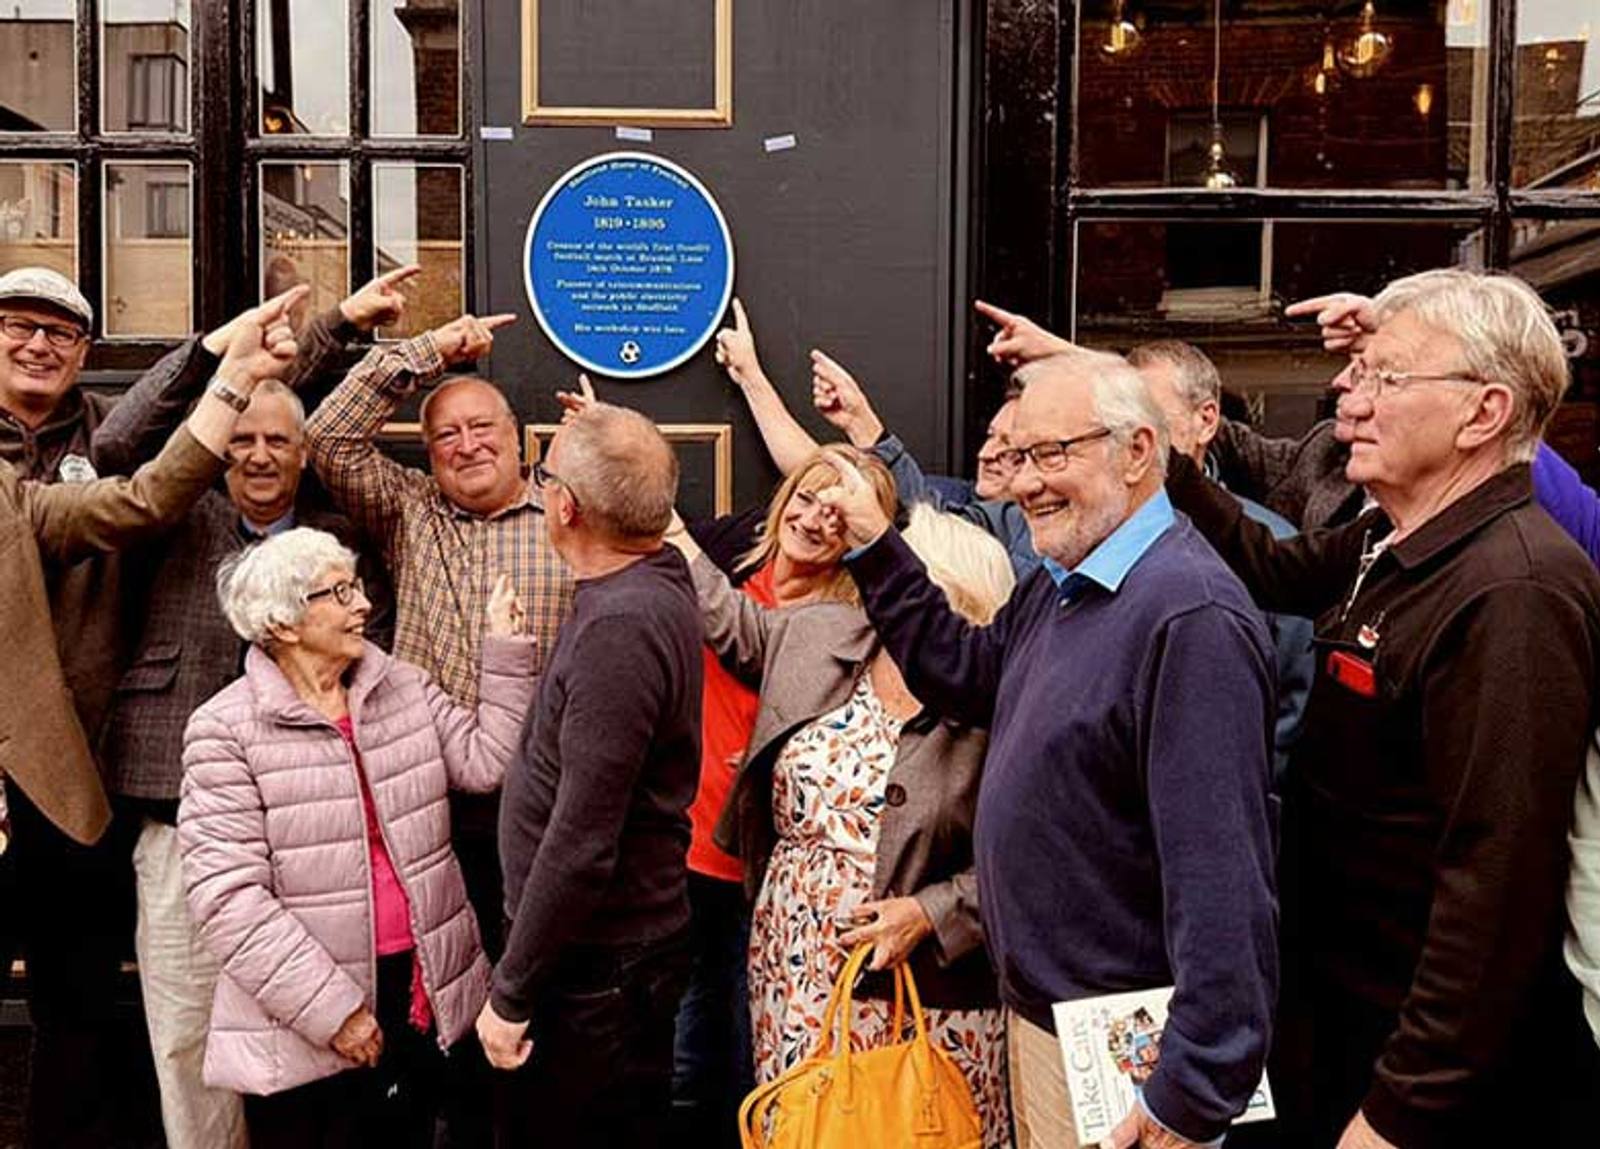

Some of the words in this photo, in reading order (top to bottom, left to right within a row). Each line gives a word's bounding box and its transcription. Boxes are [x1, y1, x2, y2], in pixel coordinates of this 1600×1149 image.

[583, 195, 619, 208] John
[624, 195, 674, 209] Tasker
[1078, 1077, 1105, 1139] Take
